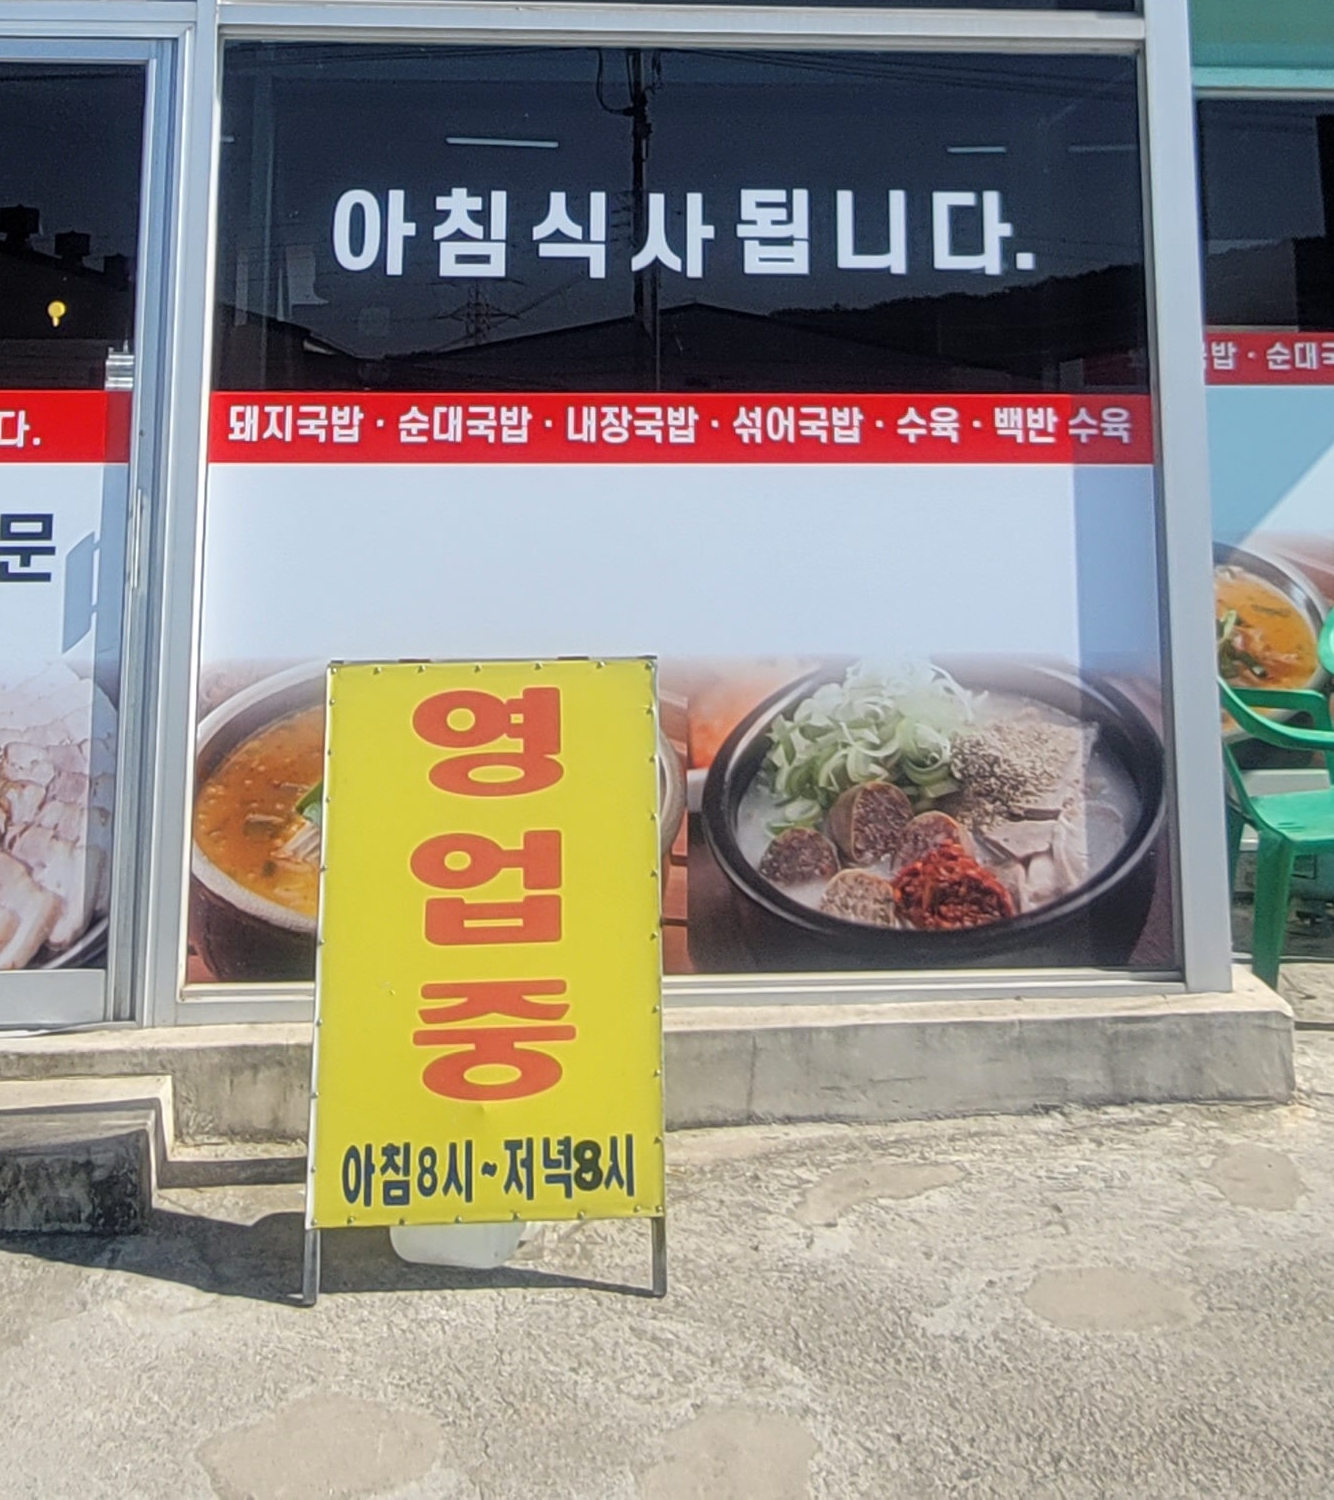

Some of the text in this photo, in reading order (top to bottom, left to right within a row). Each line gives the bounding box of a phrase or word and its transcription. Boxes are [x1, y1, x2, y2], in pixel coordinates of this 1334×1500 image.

[227, 404, 1131, 444] 돼지국밥 순대국밥 내장국밥 섞어국밥 수육 백반 수육
[409, 686, 577, 1102] 영업중
